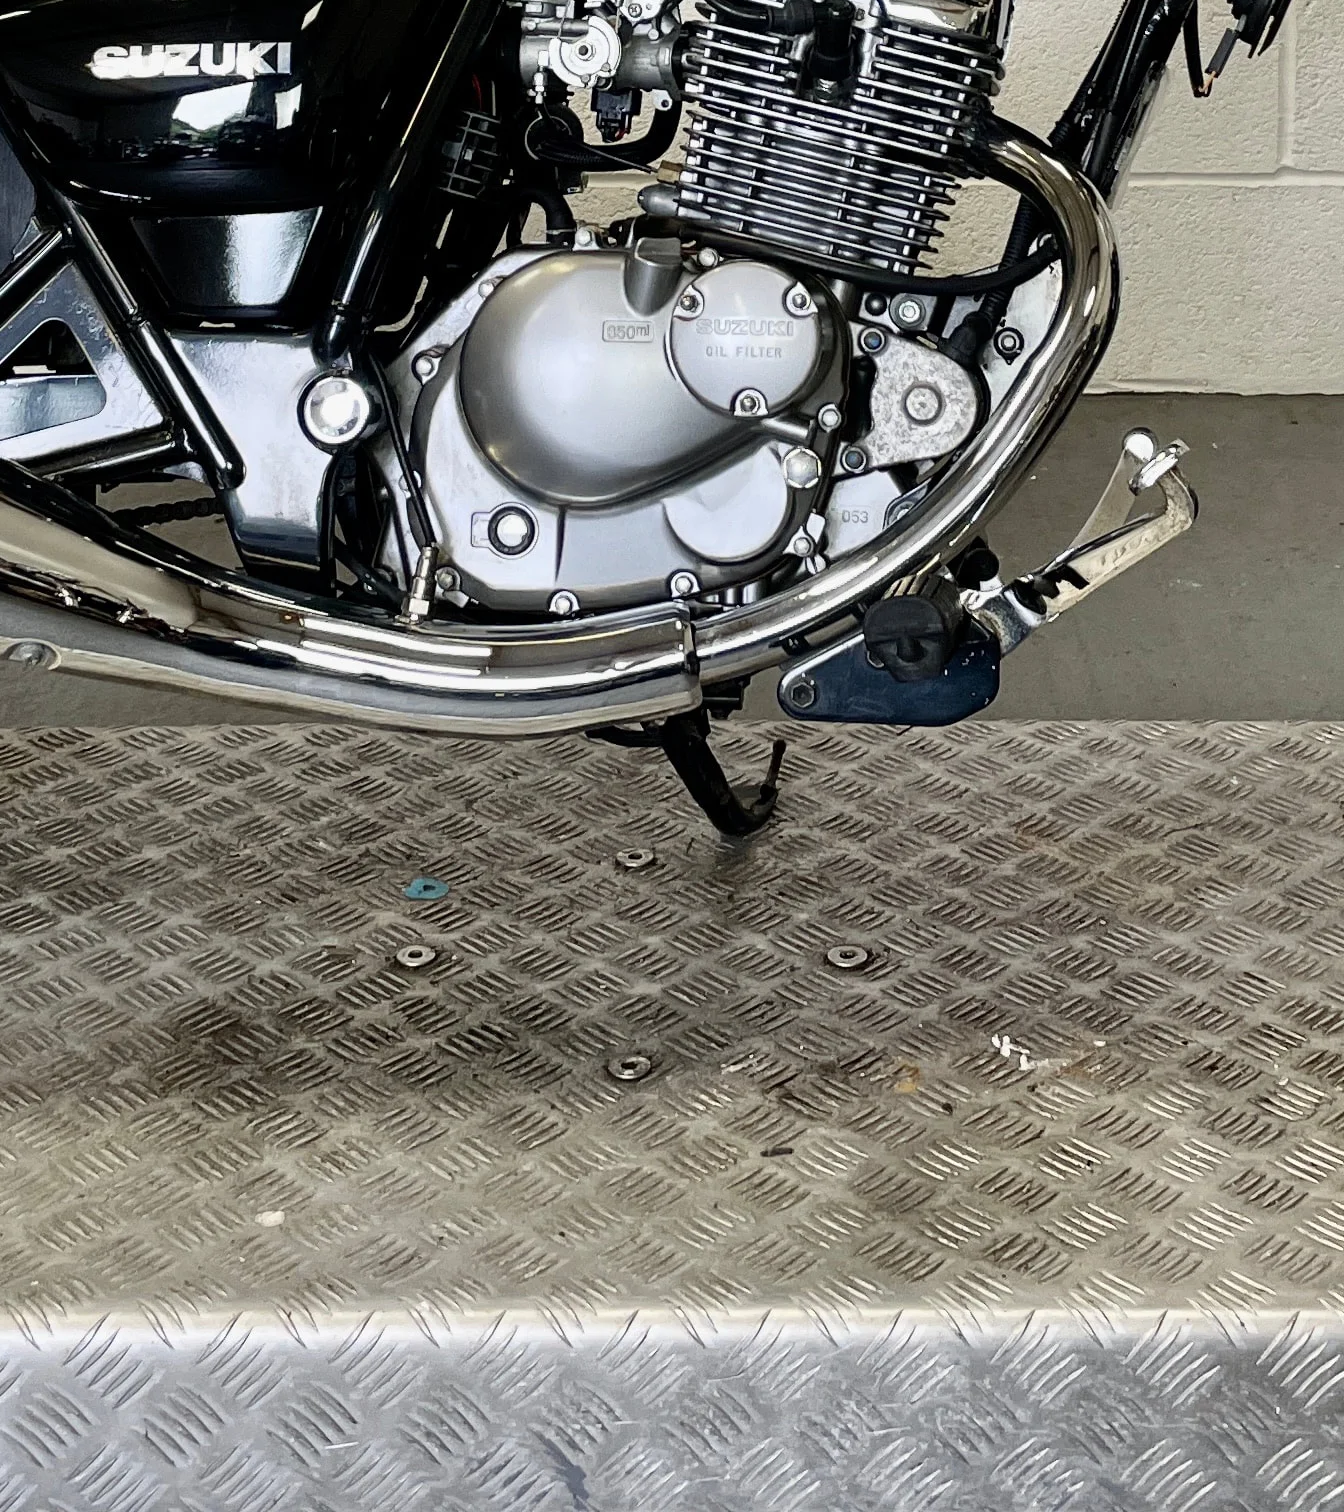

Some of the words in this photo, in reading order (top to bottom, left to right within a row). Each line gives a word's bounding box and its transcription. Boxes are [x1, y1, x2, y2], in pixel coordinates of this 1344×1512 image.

[90, 41, 292, 79] SUZUKI
[695, 319, 795, 337] SUZUKI
[705, 346, 727, 357] OIL
[736, 346, 783, 359] FILTER
